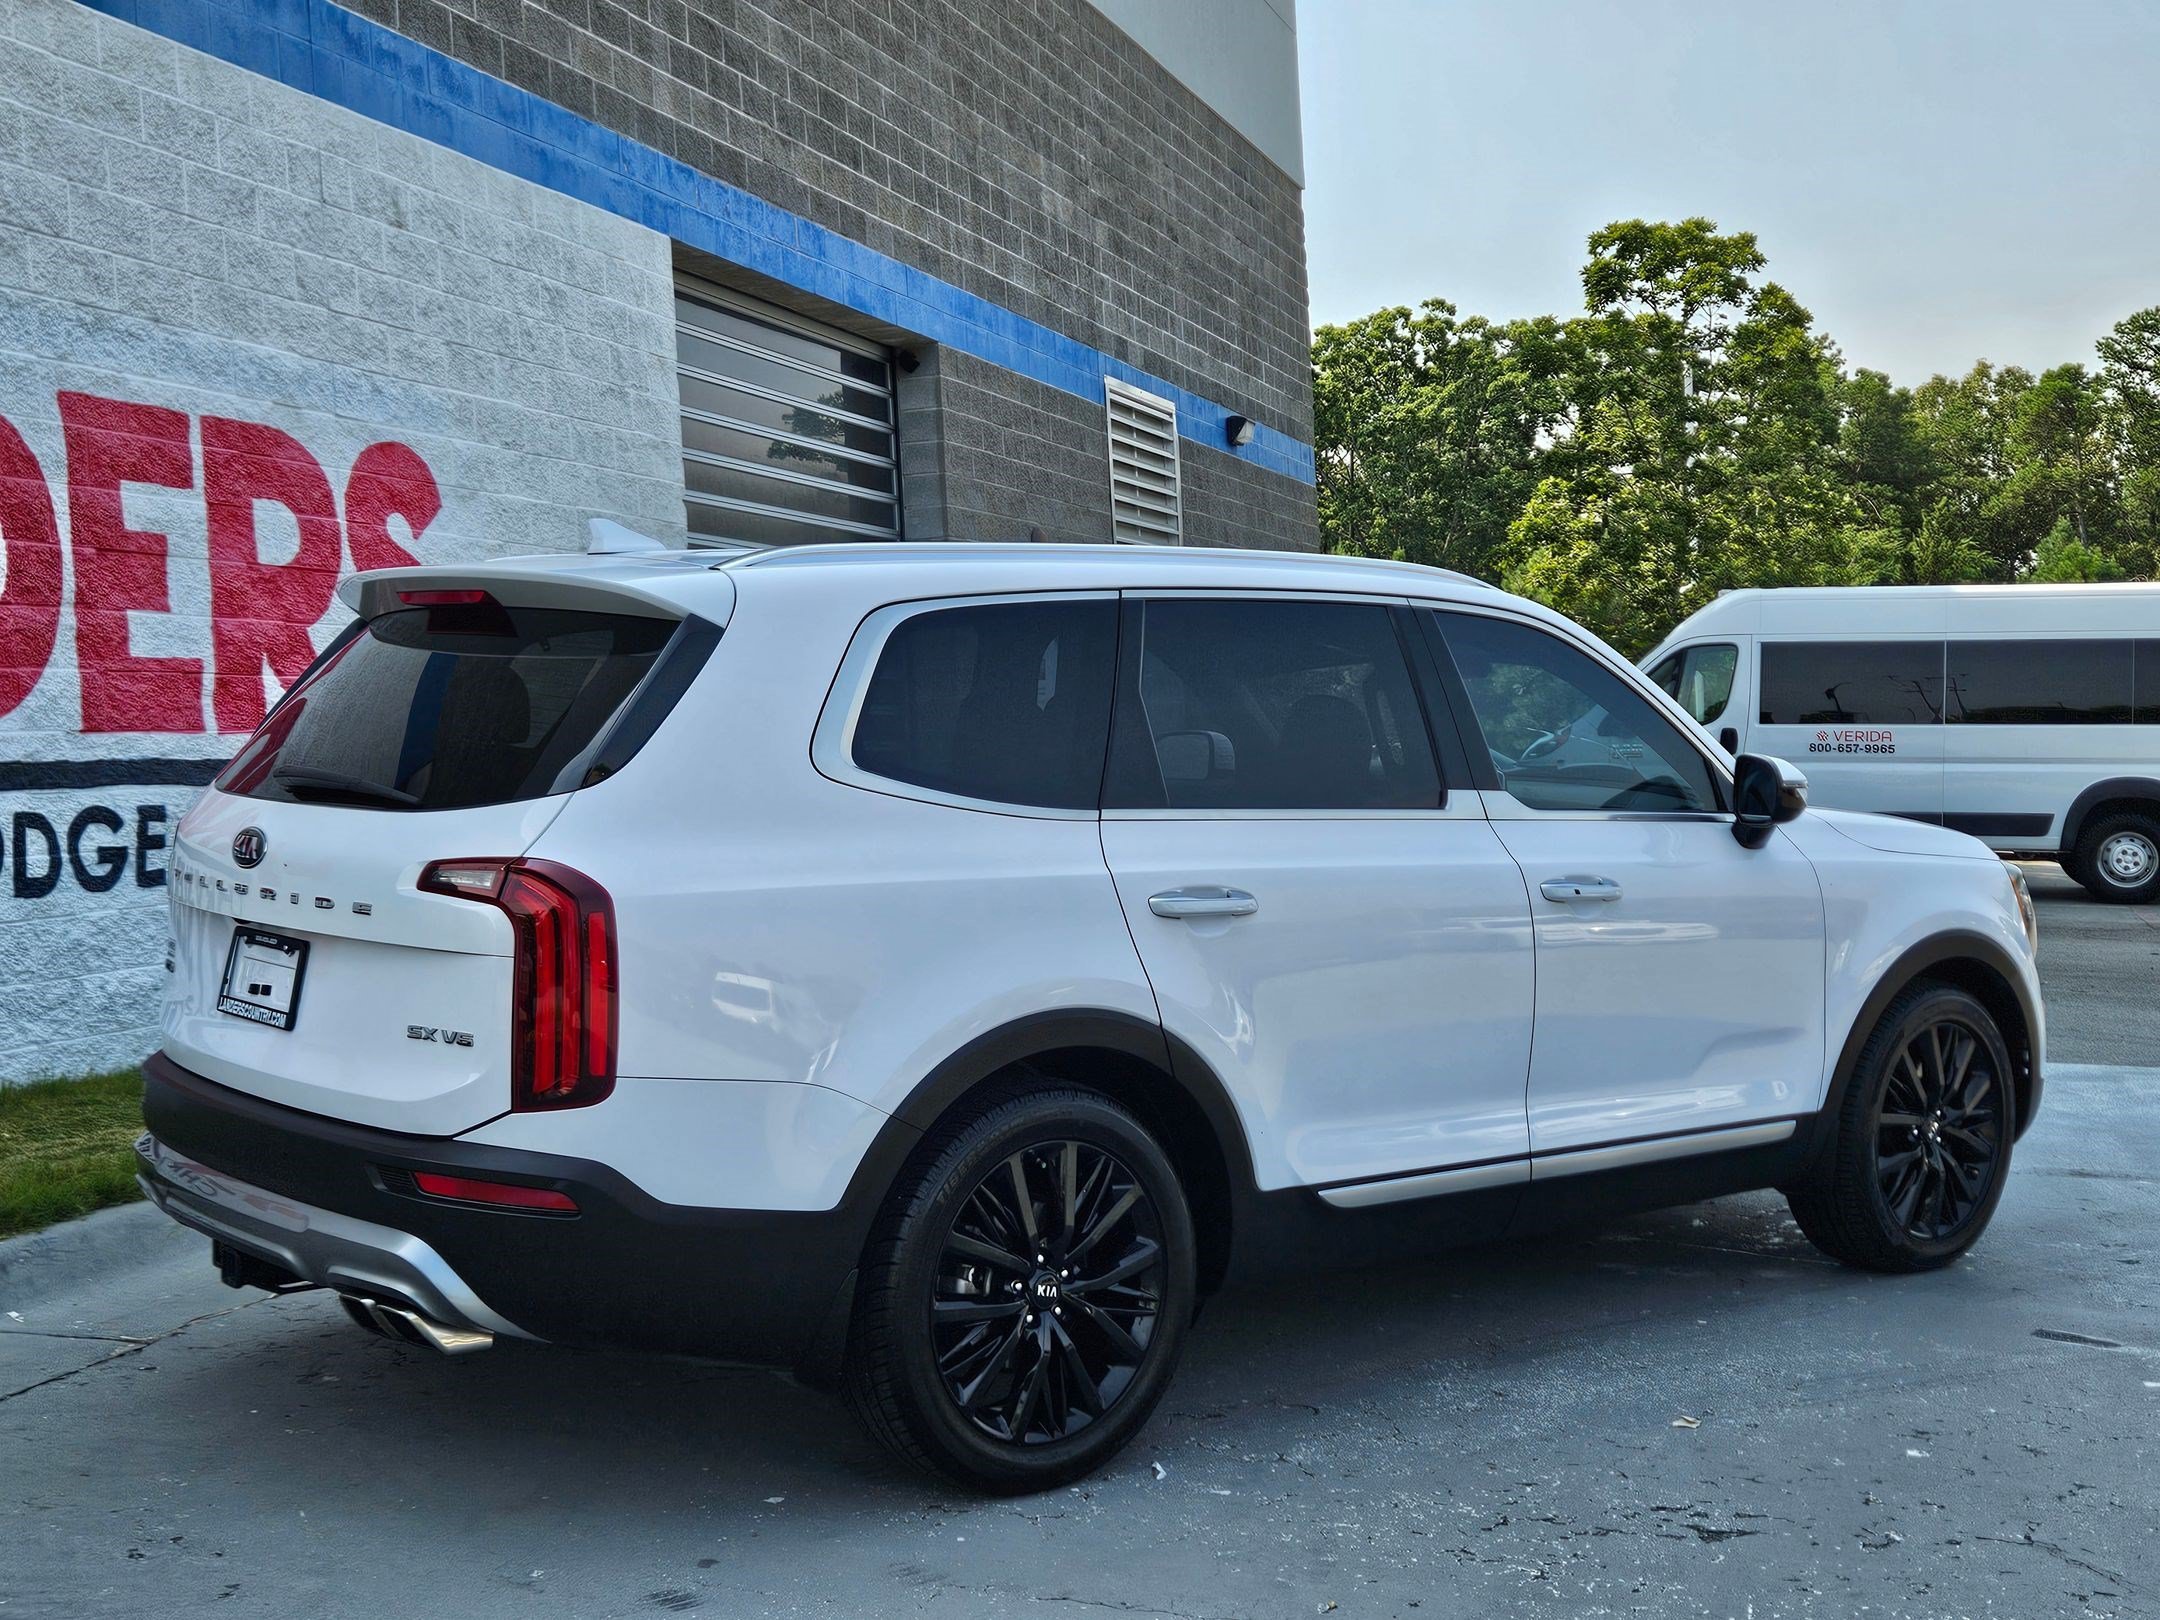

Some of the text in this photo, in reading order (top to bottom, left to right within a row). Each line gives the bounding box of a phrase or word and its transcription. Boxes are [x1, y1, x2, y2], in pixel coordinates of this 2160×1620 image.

[1833, 730, 1892, 742] VERIDA
[1808, 743, 1896, 754] 800-657-9965
[0, 804, 168, 898] DGE
[174, 867, 373, 917] TELLURIDE
[406, 1024, 475, 1048] SX V6
[1037, 1284, 1057, 1298] KIA
